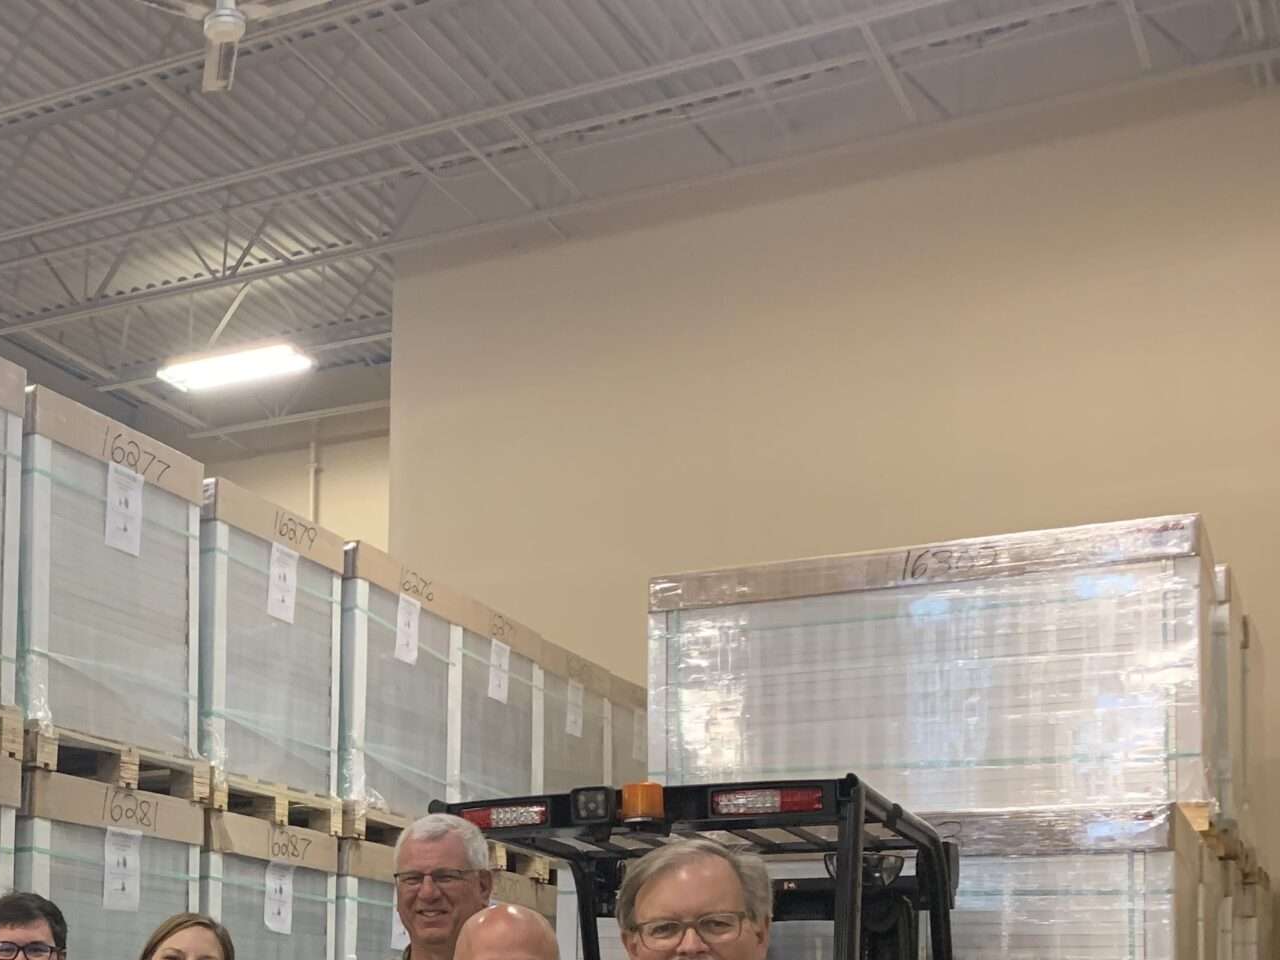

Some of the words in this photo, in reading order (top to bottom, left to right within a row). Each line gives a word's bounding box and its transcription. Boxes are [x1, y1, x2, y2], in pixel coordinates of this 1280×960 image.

[102, 425, 171, 482] 16277
[274, 511, 318, 551] 16279
[102, 786, 159, 833] 16281
[267, 828, 312, 860] 16287
